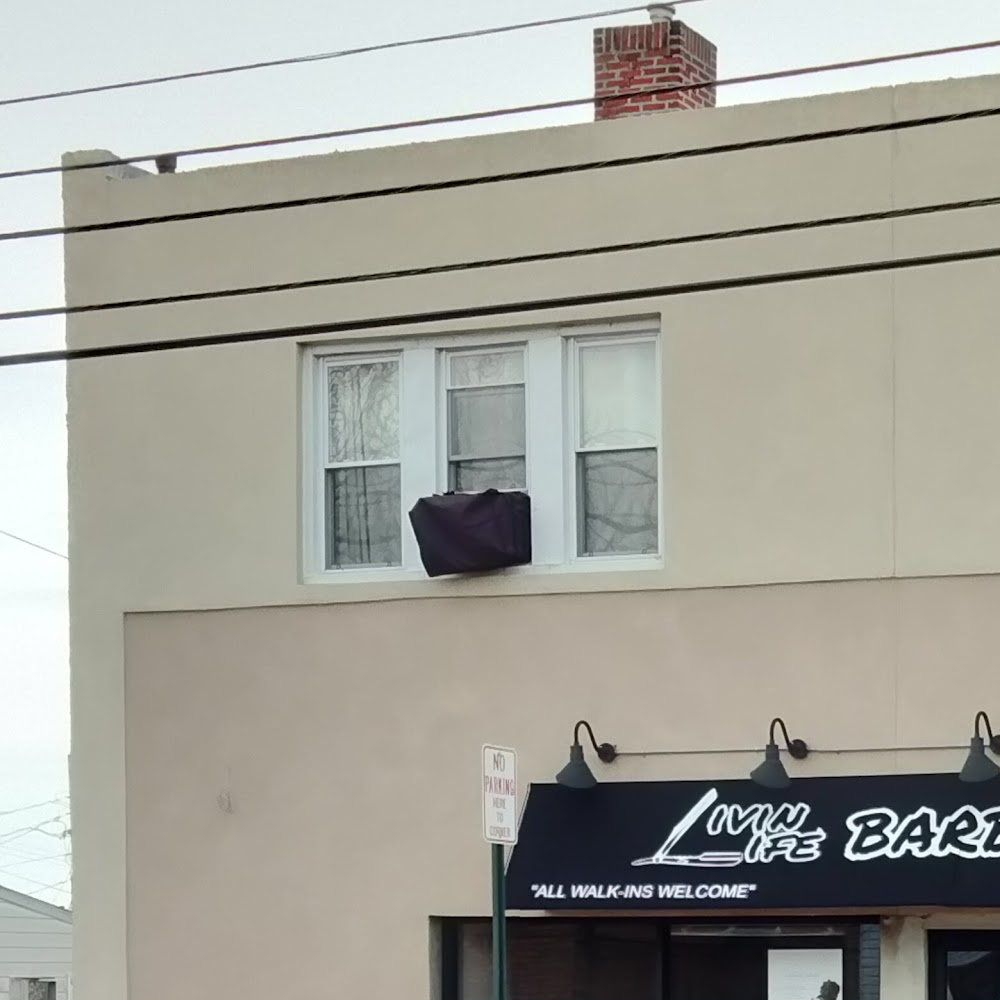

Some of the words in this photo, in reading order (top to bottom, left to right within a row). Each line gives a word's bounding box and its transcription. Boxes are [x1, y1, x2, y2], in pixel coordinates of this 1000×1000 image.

[493, 752, 506, 772] NO
[484, 776, 517, 796] PARKING
[570, 884, 654, 899] WALK-INS
